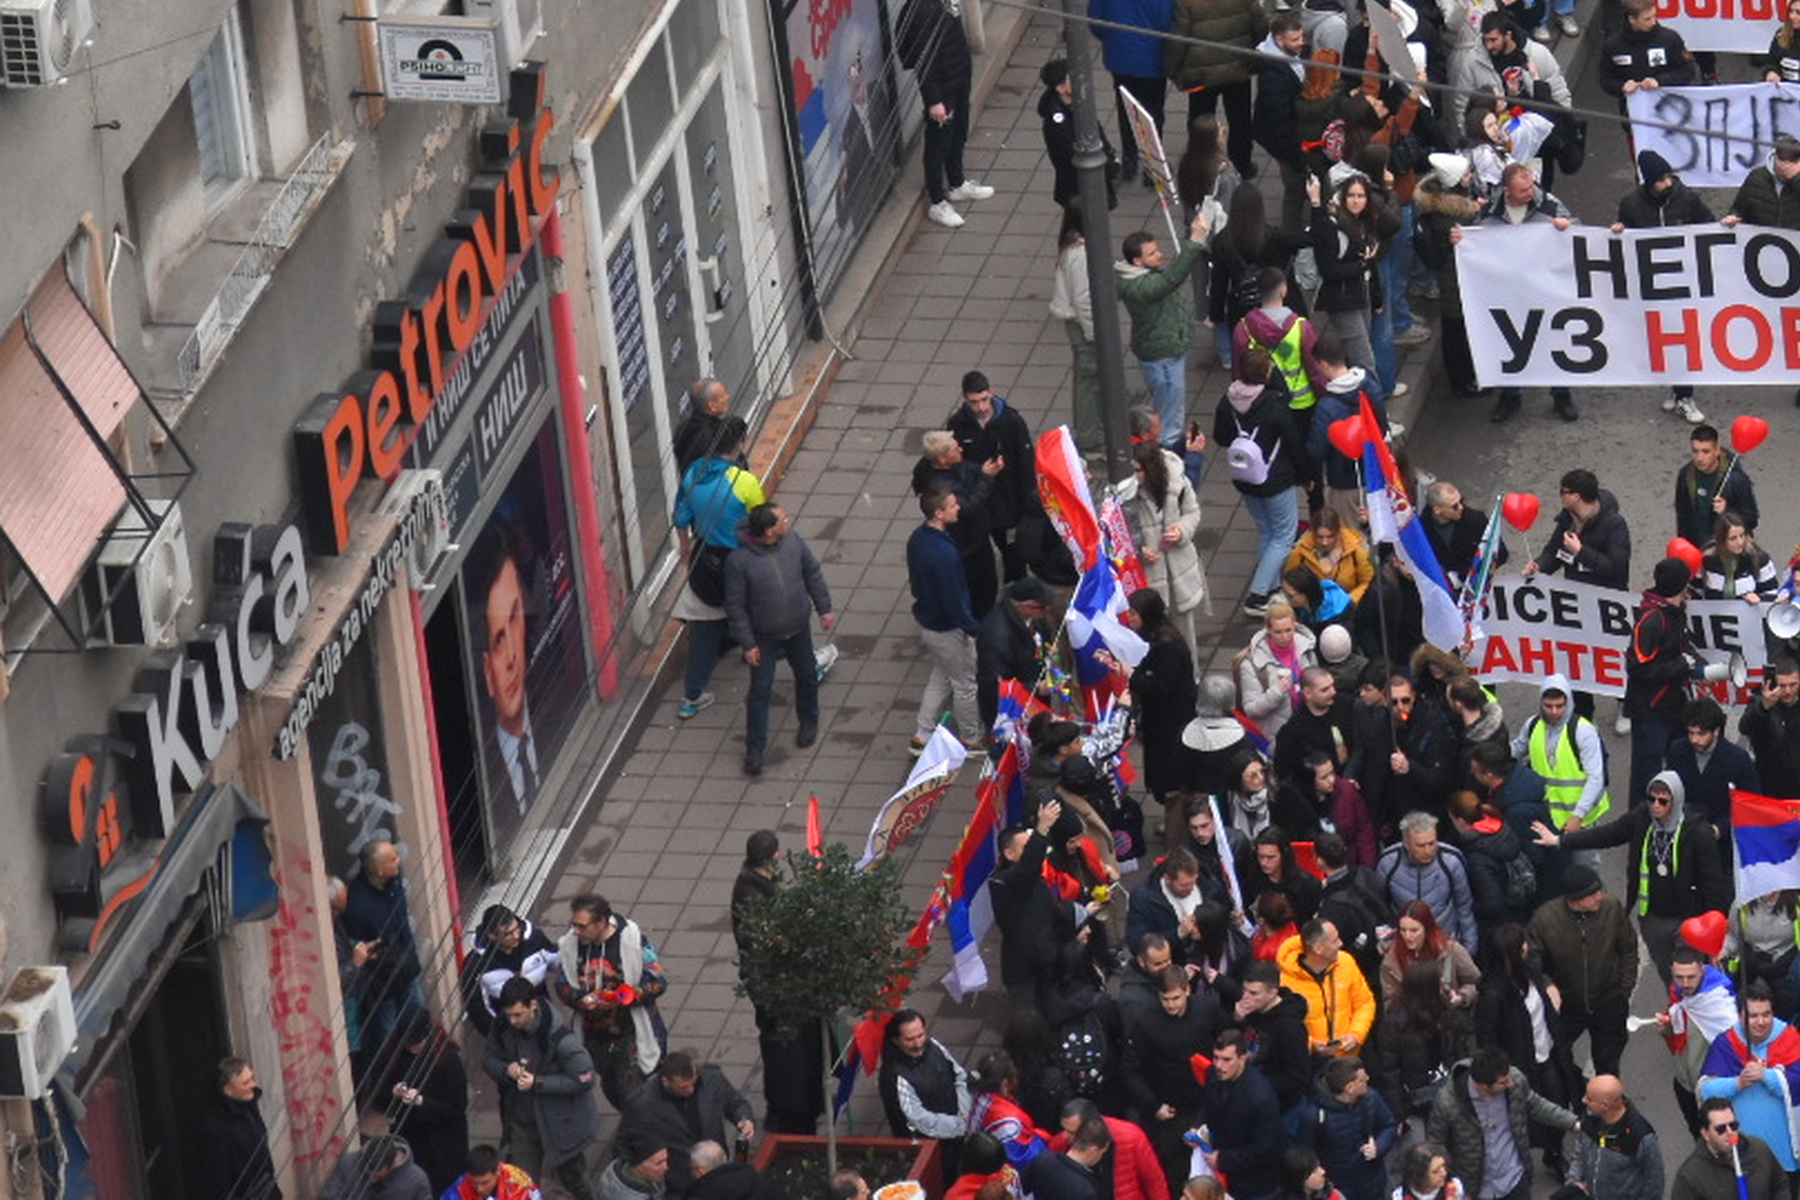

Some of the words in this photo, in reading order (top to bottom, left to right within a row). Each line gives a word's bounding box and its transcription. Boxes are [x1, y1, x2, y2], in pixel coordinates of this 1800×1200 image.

[480, 350, 529, 463] НИШ
[1489, 307, 1609, 375] УЗ
[145, 524, 311, 838] Kuća
[321, 60, 561, 555] Petrović
[276, 647, 343, 761] agencija
[339, 611, 362, 655] za
